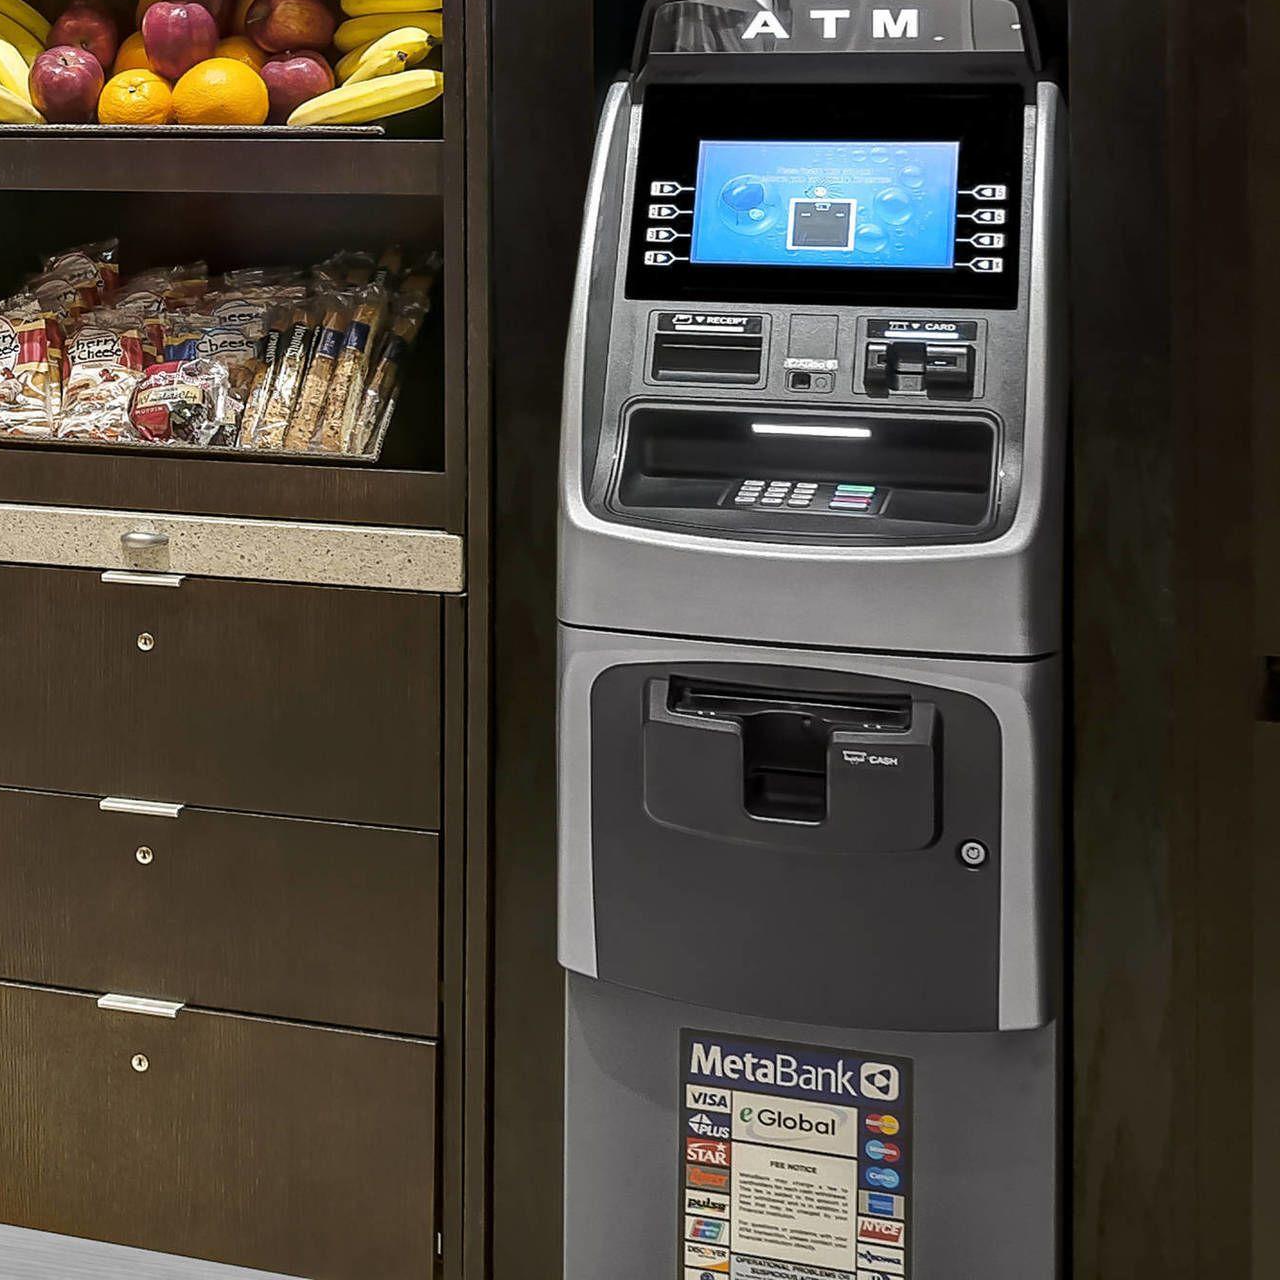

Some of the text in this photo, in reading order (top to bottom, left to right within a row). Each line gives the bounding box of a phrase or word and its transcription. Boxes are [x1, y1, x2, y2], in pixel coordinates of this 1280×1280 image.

[741, 8, 918, 40] ATM
[706, 316, 748, 326] RECEIPT
[924, 323, 957, 332] CARD
[77, 348, 122, 361] Cheese
[196, 340, 254, 355] Cheese
[869, 756, 898, 766] CASH
[690, 1043, 858, 1097] MetaBank
[691, 1091, 728, 1109] VISA
[739, 1106, 836, 1136] e Global
[700, 1122, 730, 1139] PLUS
[687, 1148, 728, 1166] STAR
[770, 1160, 817, 1174] FEE NOTICE
[688, 1197, 727, 1213] pulse
[862, 1220, 900, 1235] NYCE
